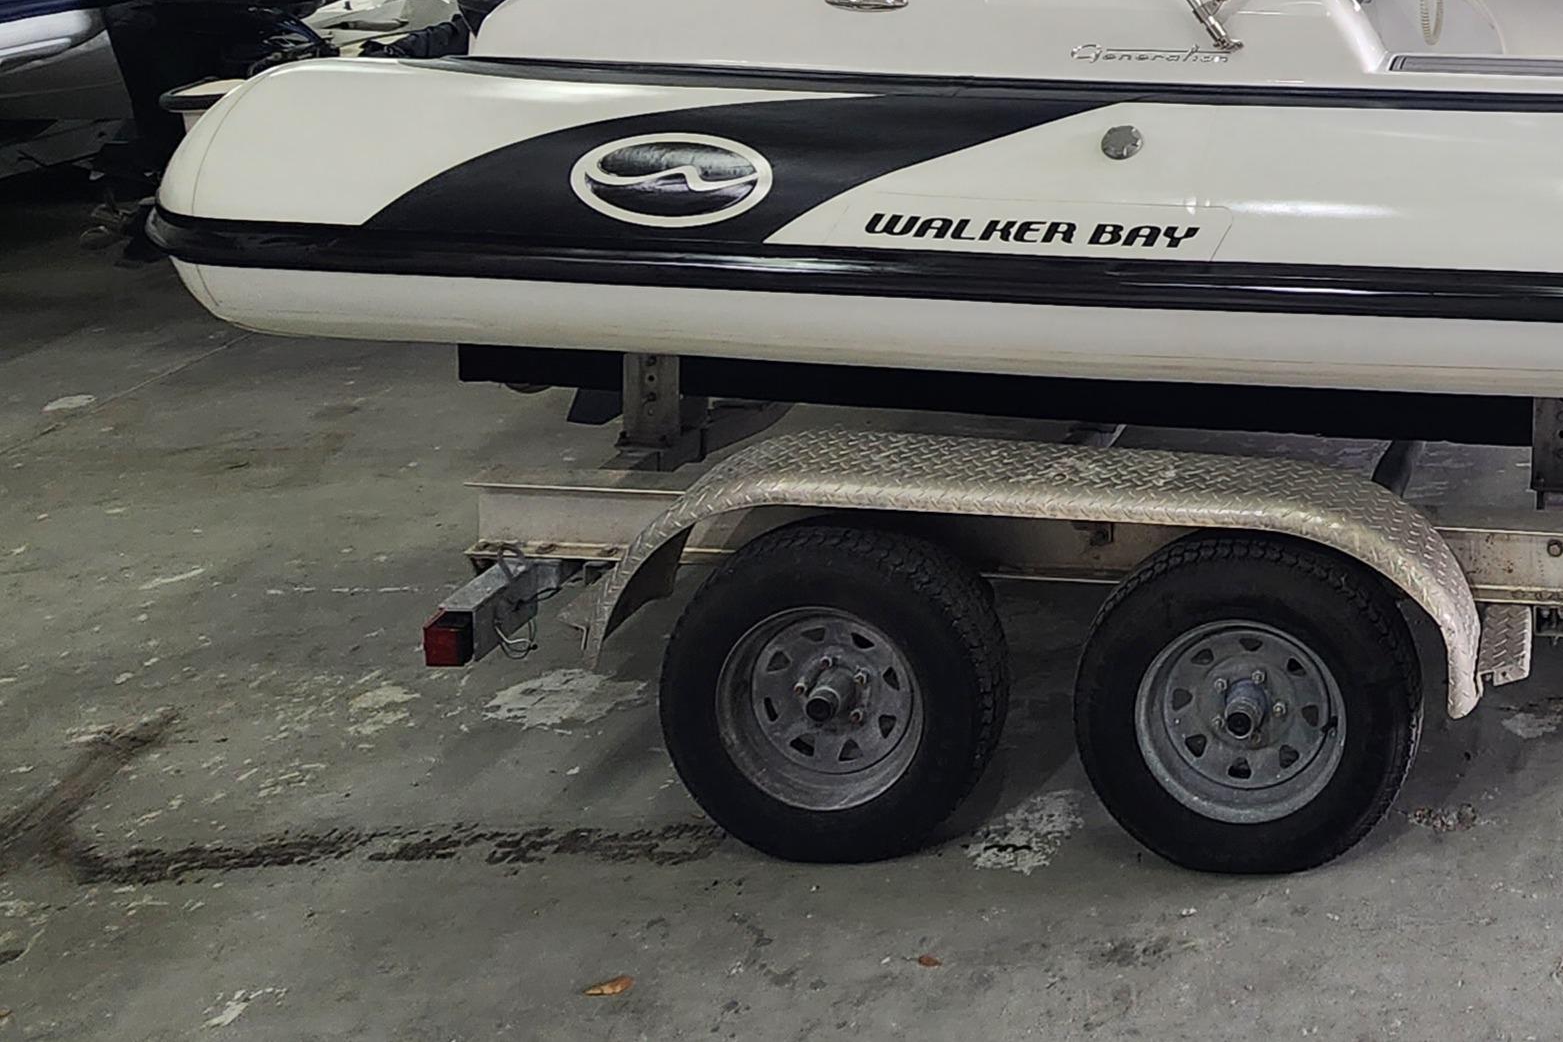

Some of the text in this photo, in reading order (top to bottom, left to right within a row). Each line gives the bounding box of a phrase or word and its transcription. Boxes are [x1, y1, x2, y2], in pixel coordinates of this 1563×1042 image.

[1071, 43, 1230, 64] Generation
[864, 212, 1201, 248] WALKER BAY
